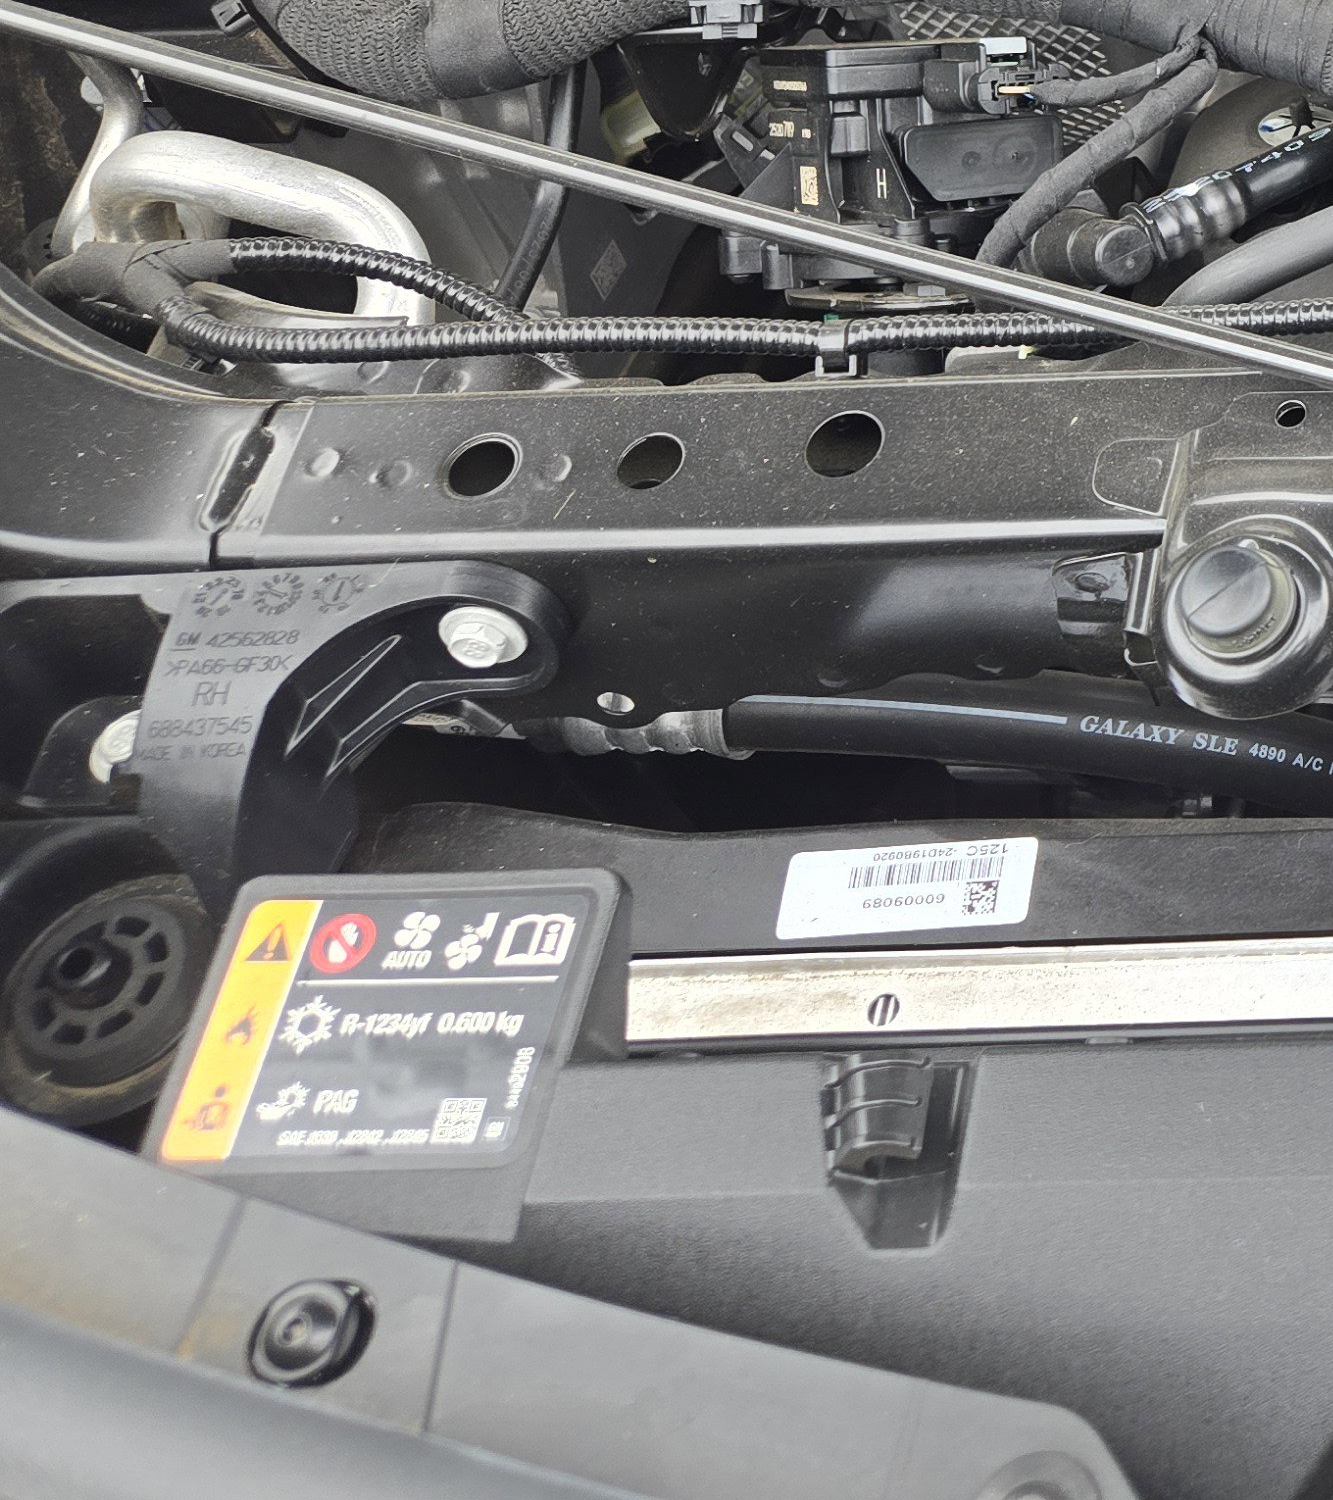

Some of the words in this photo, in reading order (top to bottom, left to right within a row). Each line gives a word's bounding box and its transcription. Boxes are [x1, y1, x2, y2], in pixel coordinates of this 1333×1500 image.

[190, 680, 233, 707] RH
[1079, 715, 1187, 747] GALAXY
[1192, 732, 1239, 757] SLE
[1248, 741, 1287, 764] 4890
[1292, 752, 1324, 772] A/C
[381, 950, 433, 971] AUTO
[339, 1012, 433, 1041] R-1234yf
[436, 1011, 496, 1037] 0.600
[495, 1011, 525, 1039] kg
[311, 1088, 360, 1116] PAG
